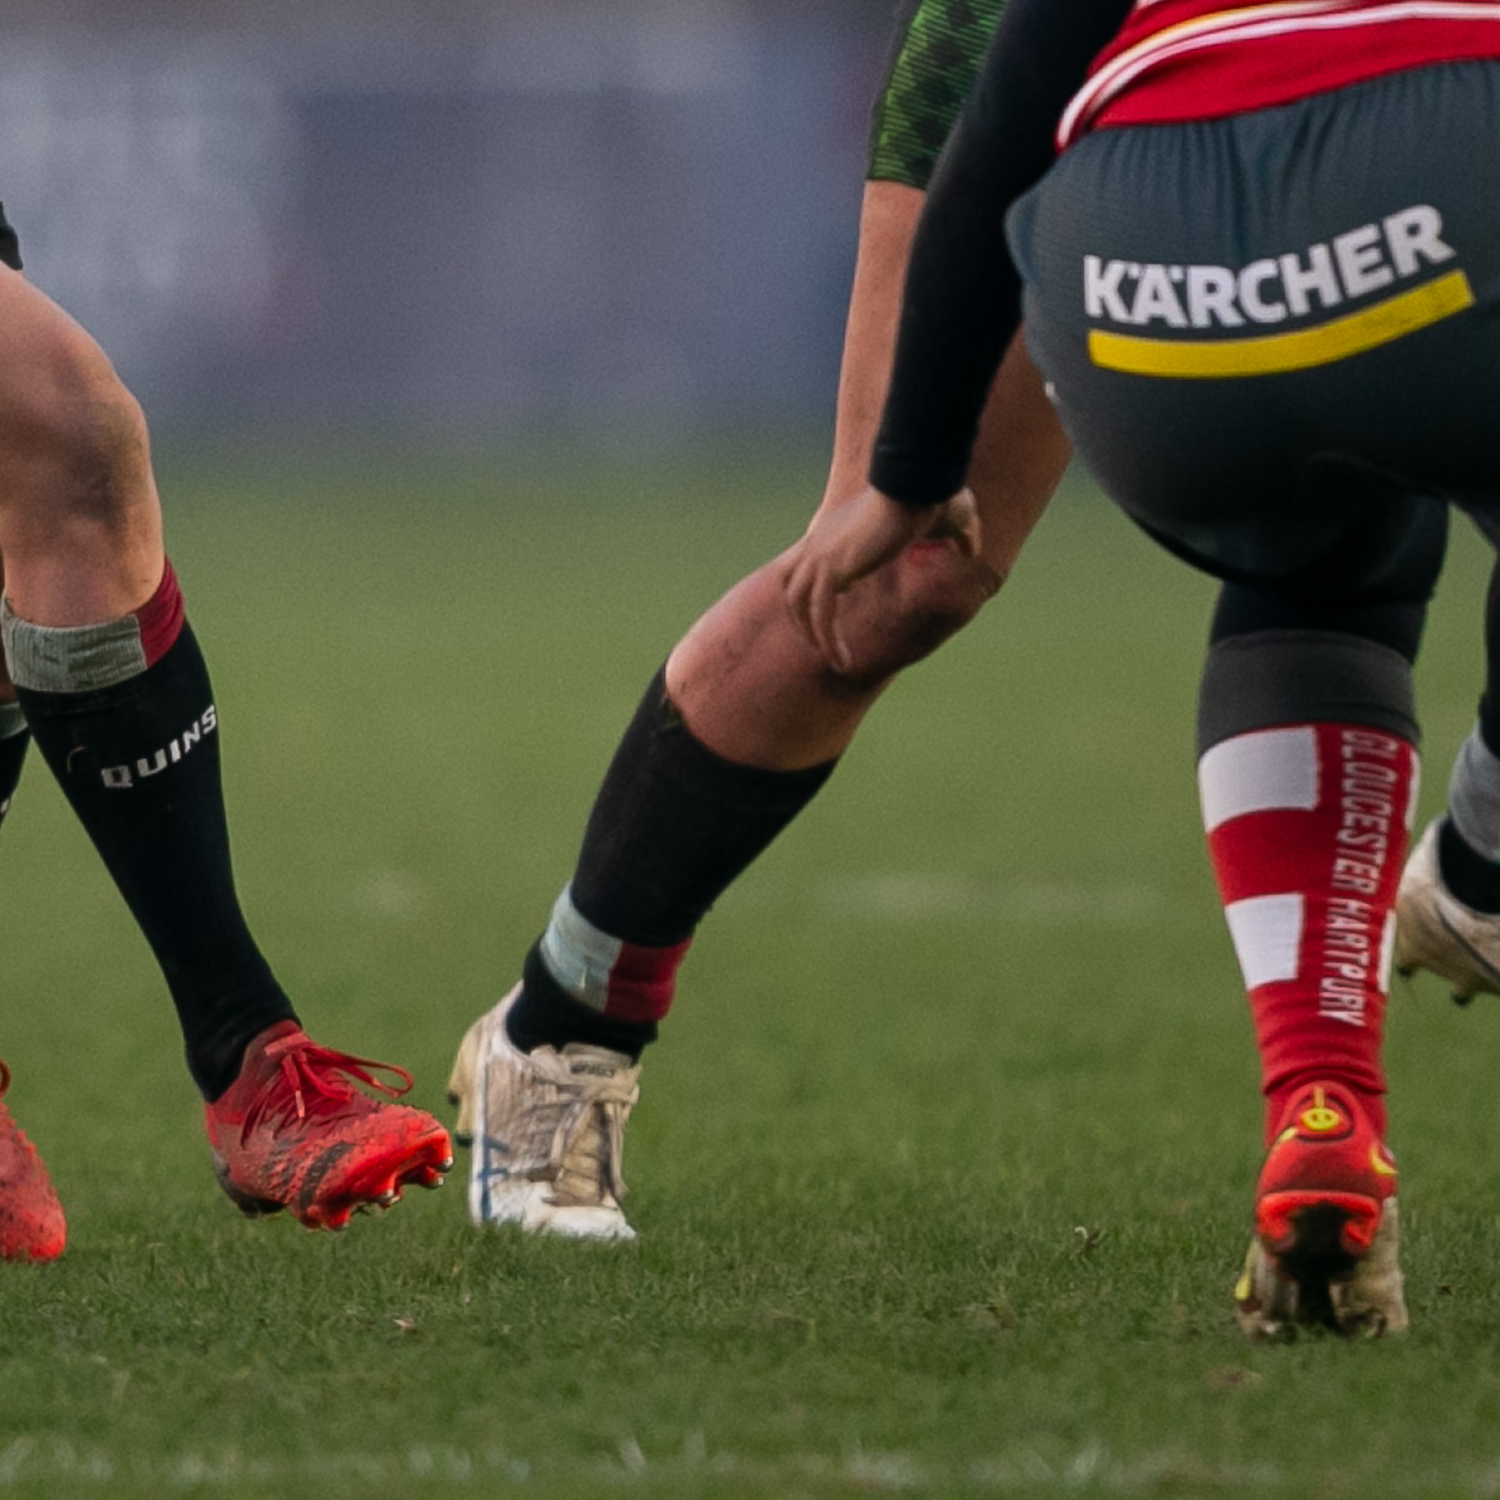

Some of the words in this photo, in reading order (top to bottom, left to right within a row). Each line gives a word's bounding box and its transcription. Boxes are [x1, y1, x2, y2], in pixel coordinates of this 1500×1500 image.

[1083, 203, 1458, 329] KÄRCHER
[100, 704, 218, 789] QUINS
[1330, 729, 1399, 896] GLOUCESTER
[1316, 897, 1370, 1028] HARTPURY
